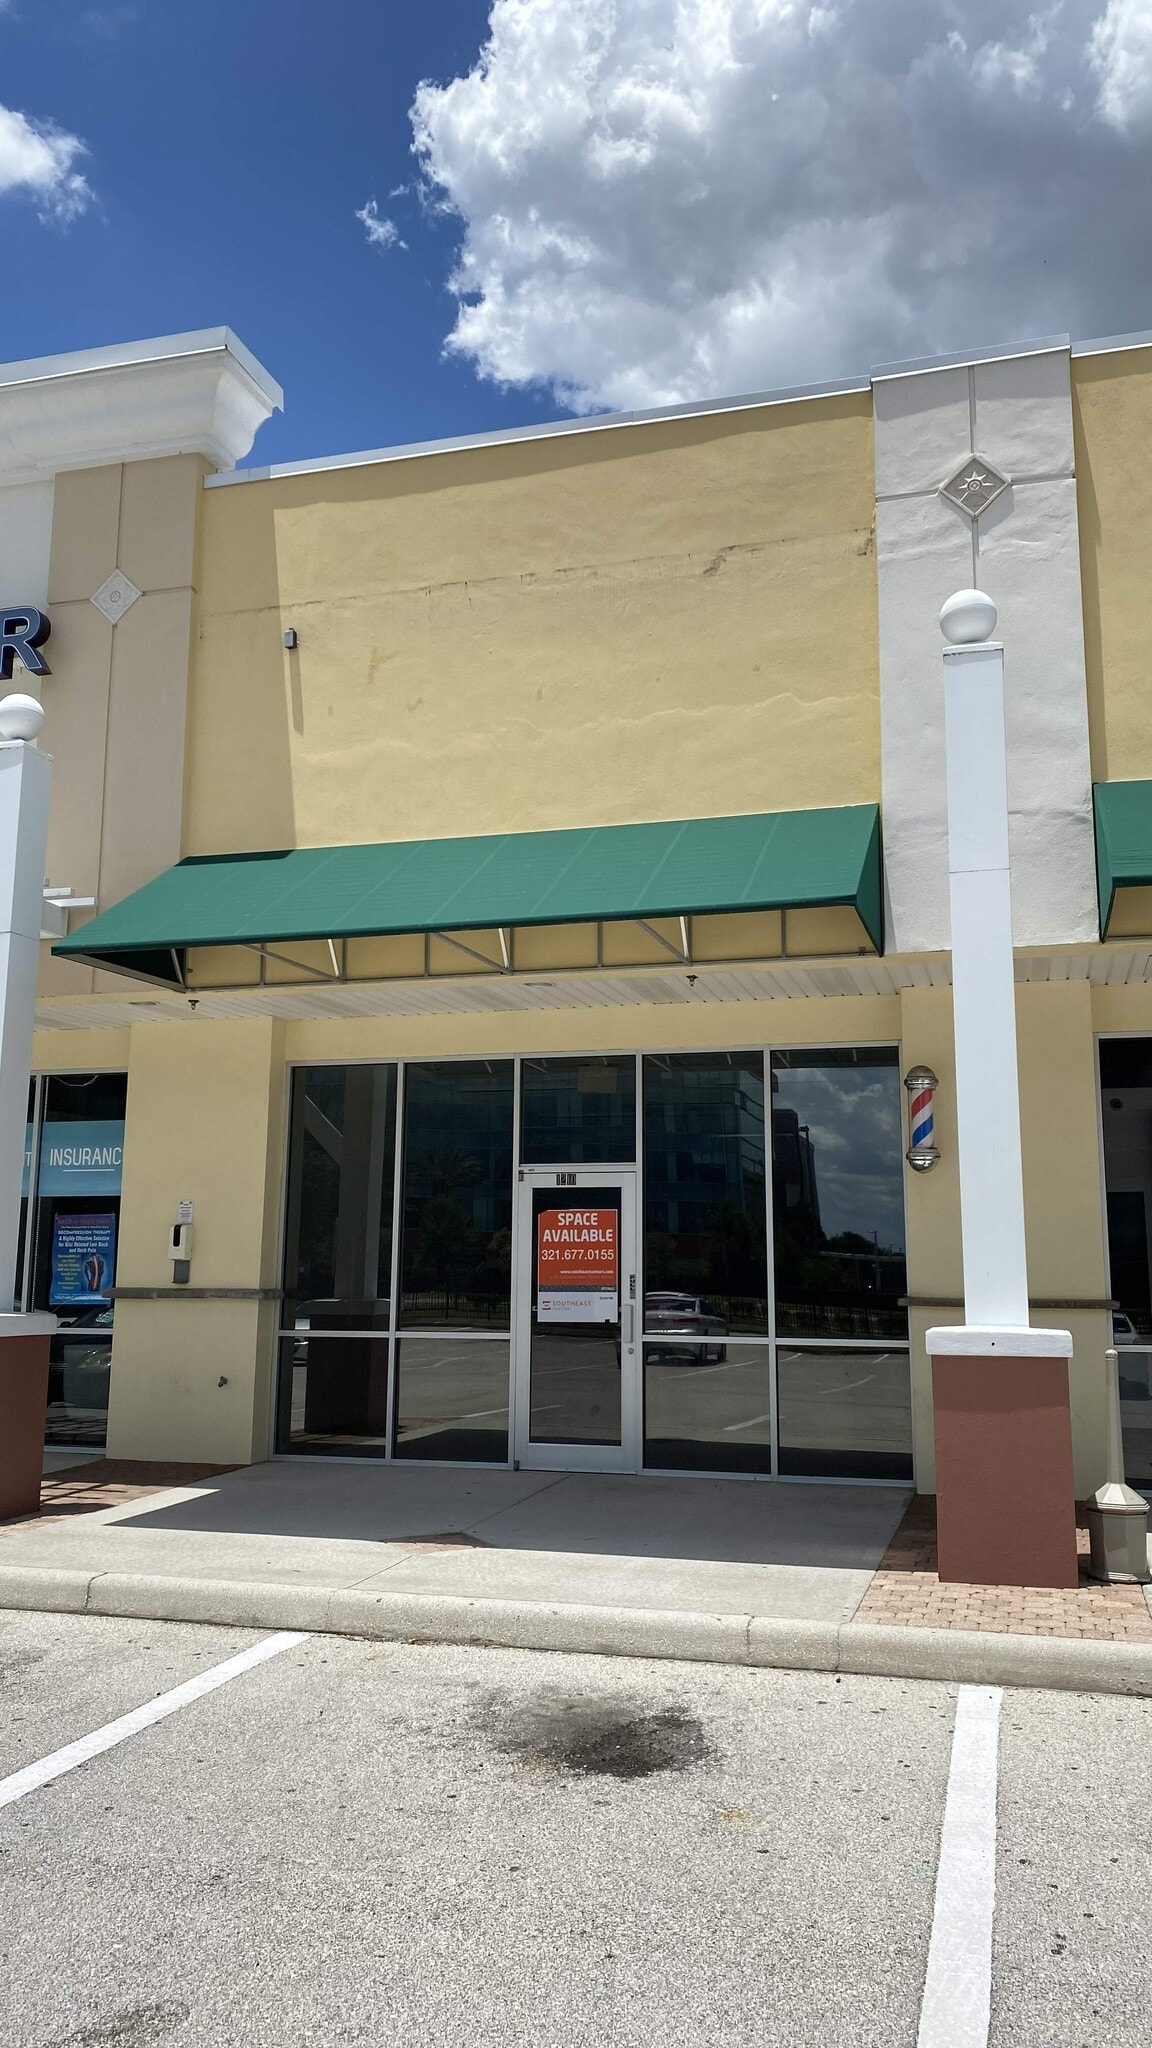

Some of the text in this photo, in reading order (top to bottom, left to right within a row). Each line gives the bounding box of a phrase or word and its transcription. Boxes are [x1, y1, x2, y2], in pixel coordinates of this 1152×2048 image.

[557, 1212, 598, 1226] SPACE
[543, 1229, 613, 1242] AVAILABLE
[541, 1249, 614, 1260] 321.677.0155
